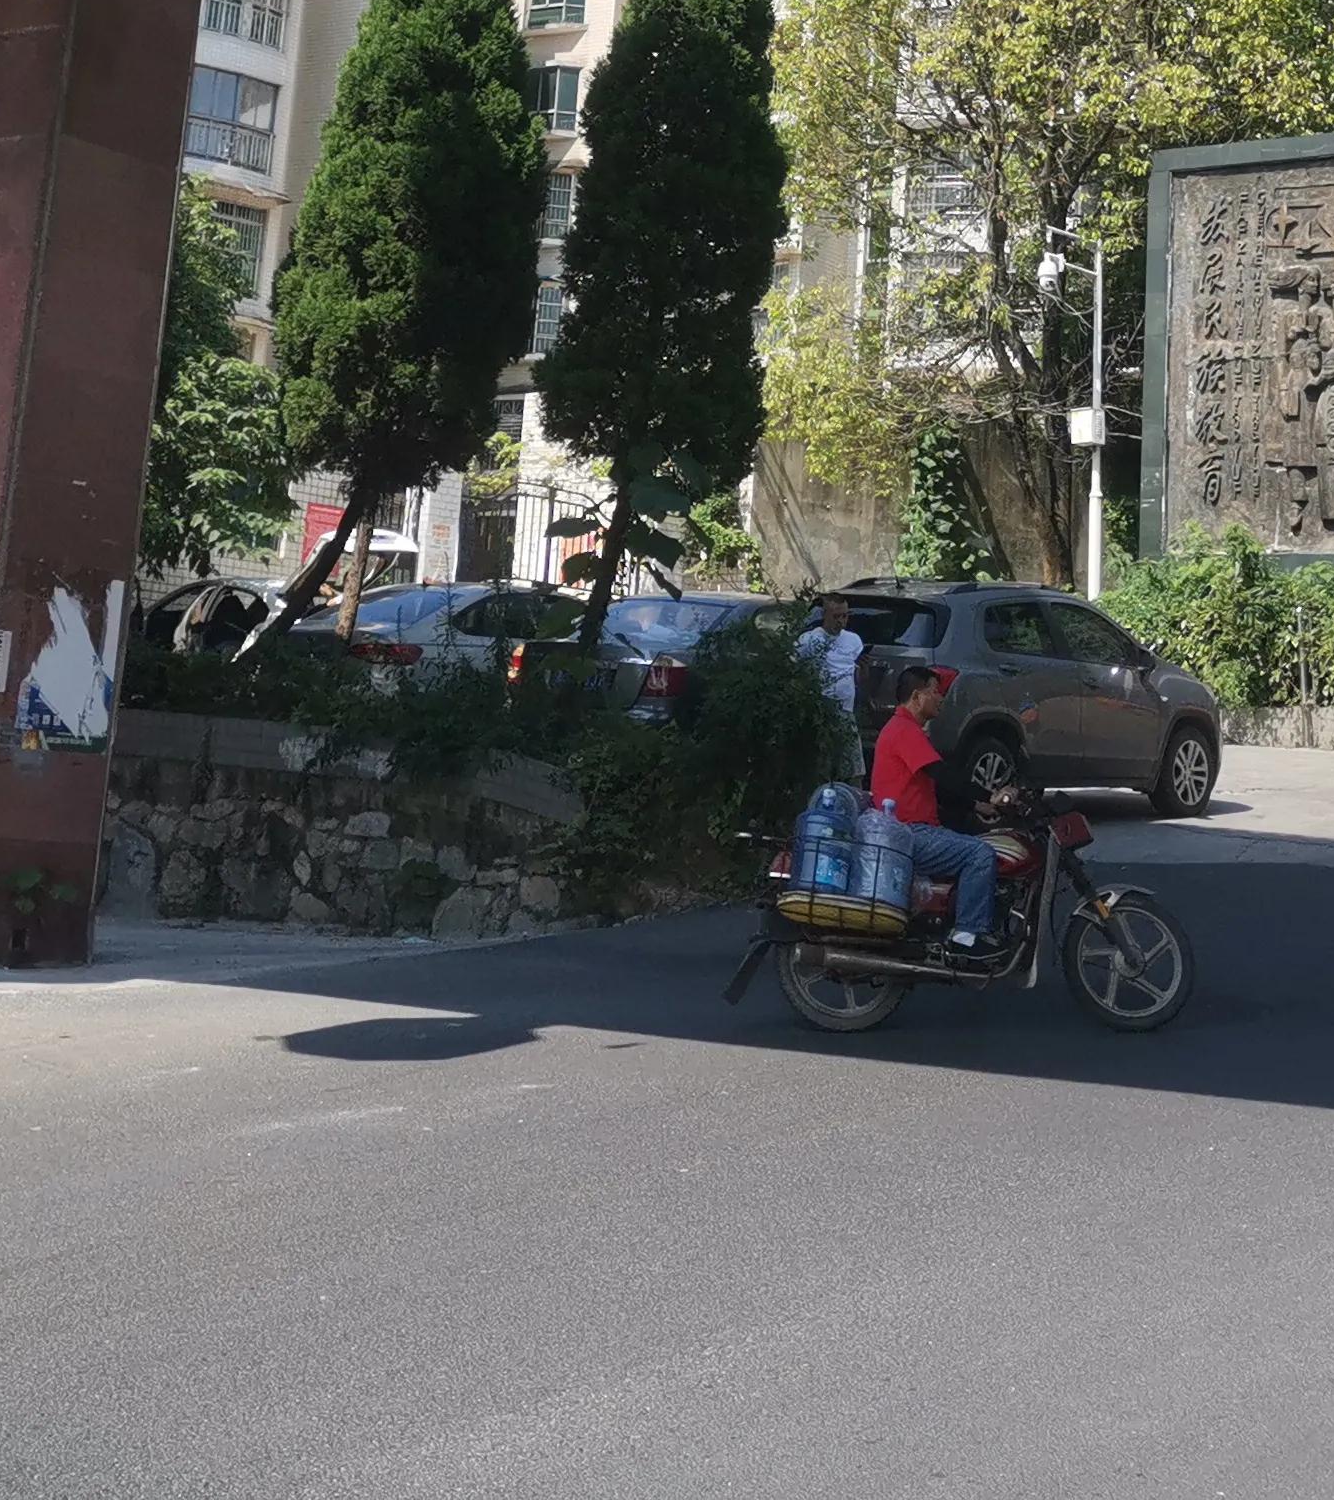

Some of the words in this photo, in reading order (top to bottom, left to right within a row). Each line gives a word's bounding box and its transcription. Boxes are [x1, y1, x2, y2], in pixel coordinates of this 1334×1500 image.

[1196, 197, 1229, 506] 发展民族教育
